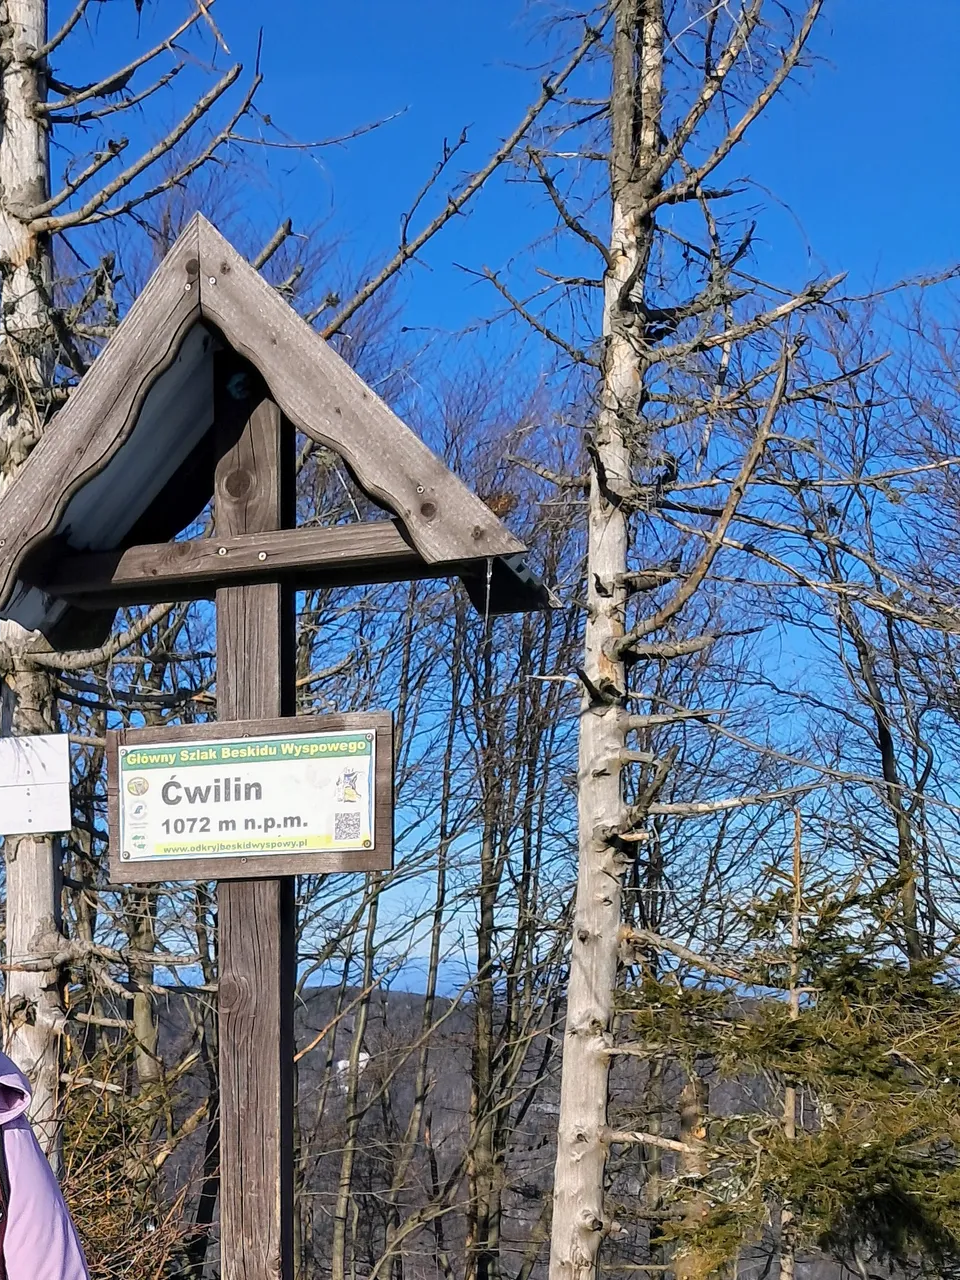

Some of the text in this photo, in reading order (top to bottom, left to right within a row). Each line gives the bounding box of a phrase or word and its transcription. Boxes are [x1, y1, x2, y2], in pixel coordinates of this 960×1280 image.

[126, 741, 366, 765] Główny Szlak Beskidu Wyspowego
[161, 775, 262, 805] Ćwilin
[161, 817, 211, 834] 1072
[218, 819, 236, 832] m
[244, 815, 308, 833] n.p.m.
[163, 839, 308, 853] www.odkryjbeskidwyspowy.pl
